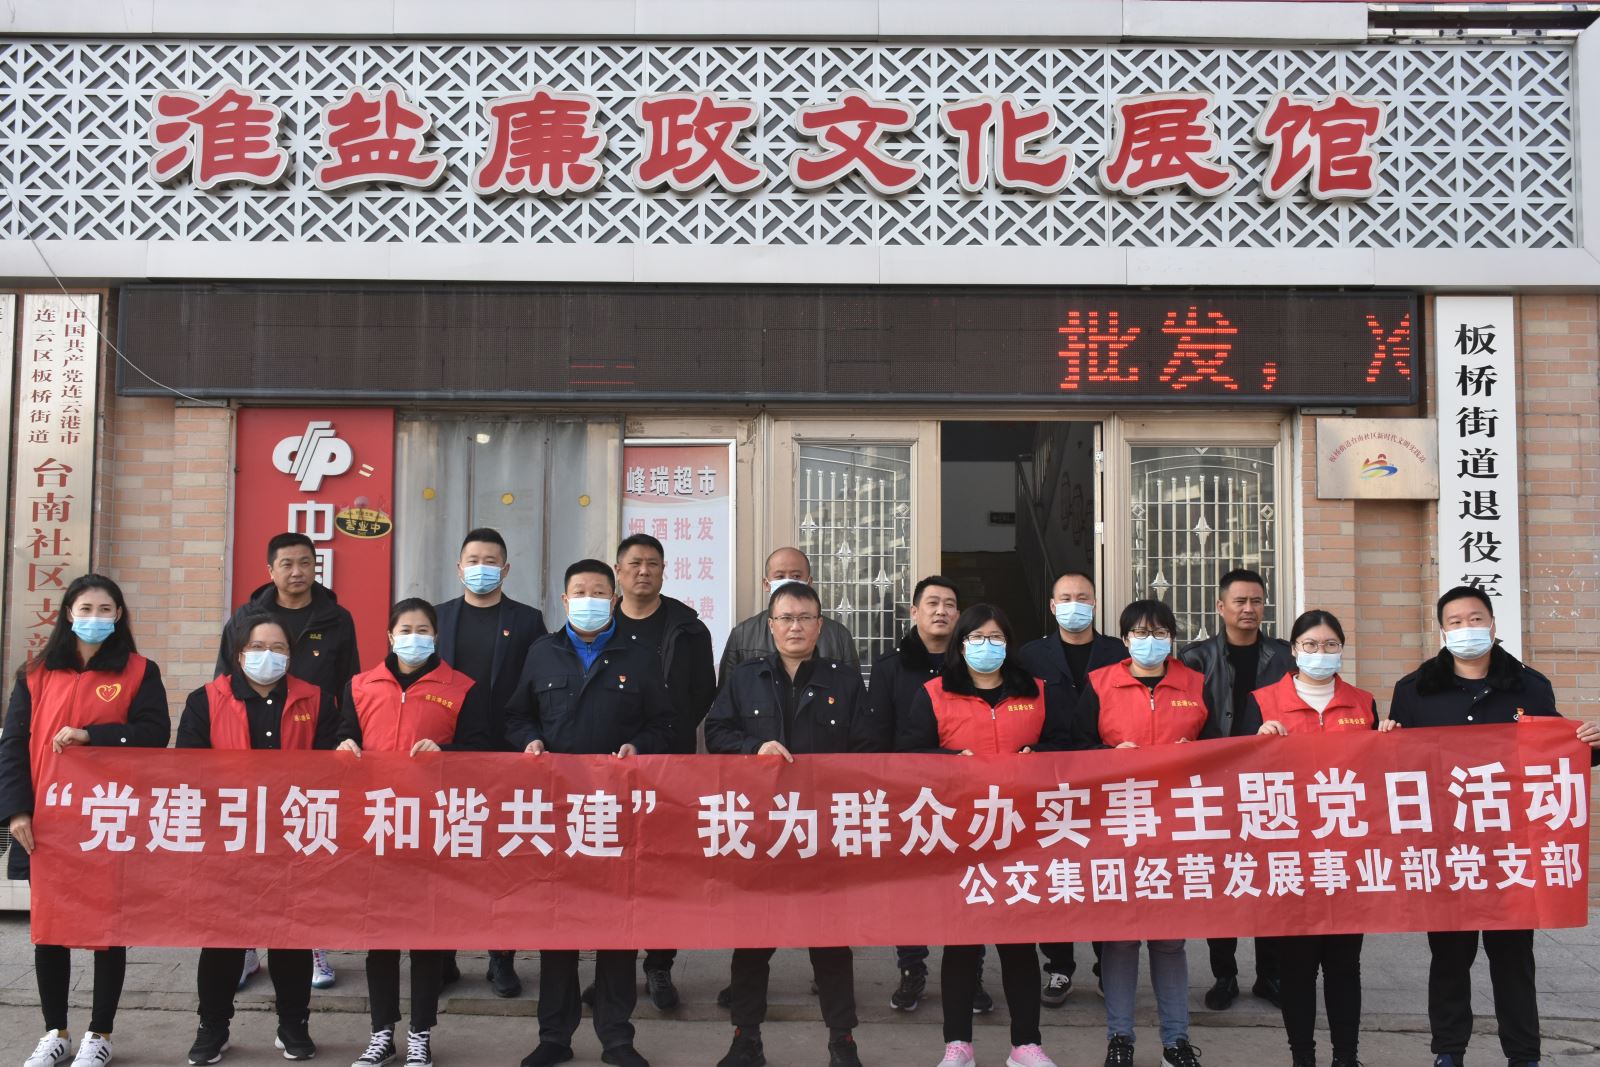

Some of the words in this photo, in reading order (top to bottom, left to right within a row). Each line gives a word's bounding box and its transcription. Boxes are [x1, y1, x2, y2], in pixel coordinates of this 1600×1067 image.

[156, 89, 1380, 198] 淮盐廉政文化展馆
[28, 308, 56, 444] 连云区板桥街道
[60, 308, 86, 445] 中国共产党连云港市
[626, 465, 717, 496] 峰瑞超市
[45, 782, 340, 856] “党建引领
[363, 787, 656, 858] 和谐共建”
[698, 757, 1588, 859] 我为群众办实事主题党日活动
[959, 840, 1582, 906] 公交集团经营发展事业部党支部
